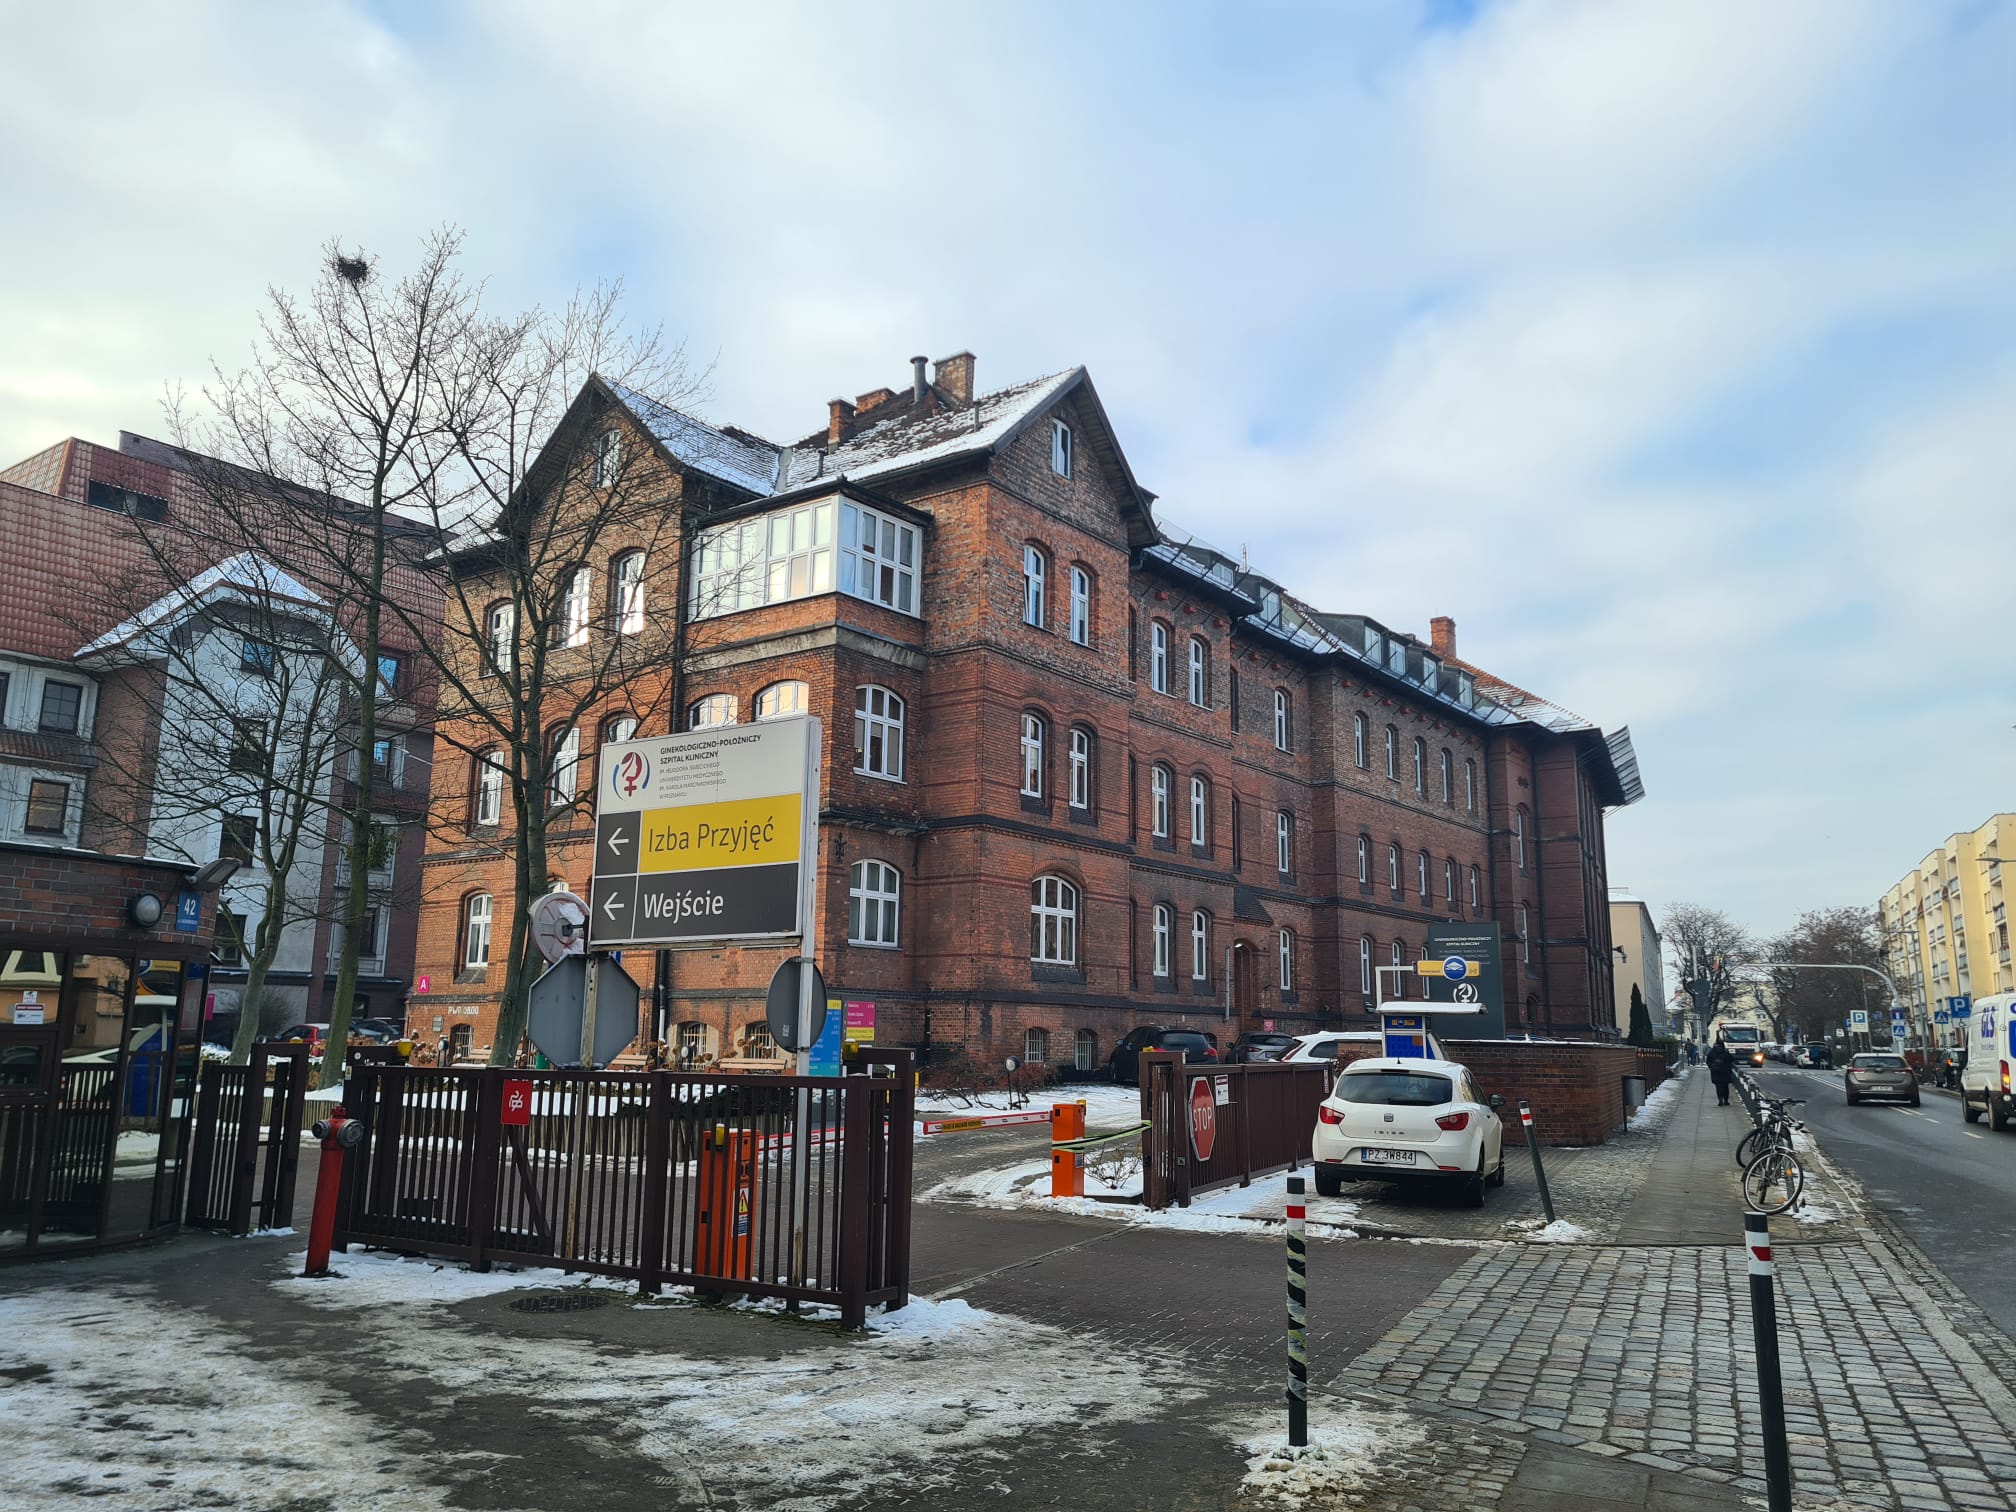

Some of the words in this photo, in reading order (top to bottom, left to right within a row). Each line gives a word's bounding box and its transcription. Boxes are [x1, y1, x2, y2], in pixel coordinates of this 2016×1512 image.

[660, 734, 762, 755] GINEKOLOGICZNO-POŁOŻNICZY
[660, 754, 684, 765] SZPITAL
[685, 750, 719, 762] KLINICZNY
[648, 824, 689, 853] Izba
[697, 815, 775, 853] Przyjęć
[184, 898, 196, 916] 42
[643, 889, 724, 924] Wejście
[420, 979, 426, 989] A
[1954, 998, 1966, 1012] P
[1193, 1106, 1212, 1132] STOP
